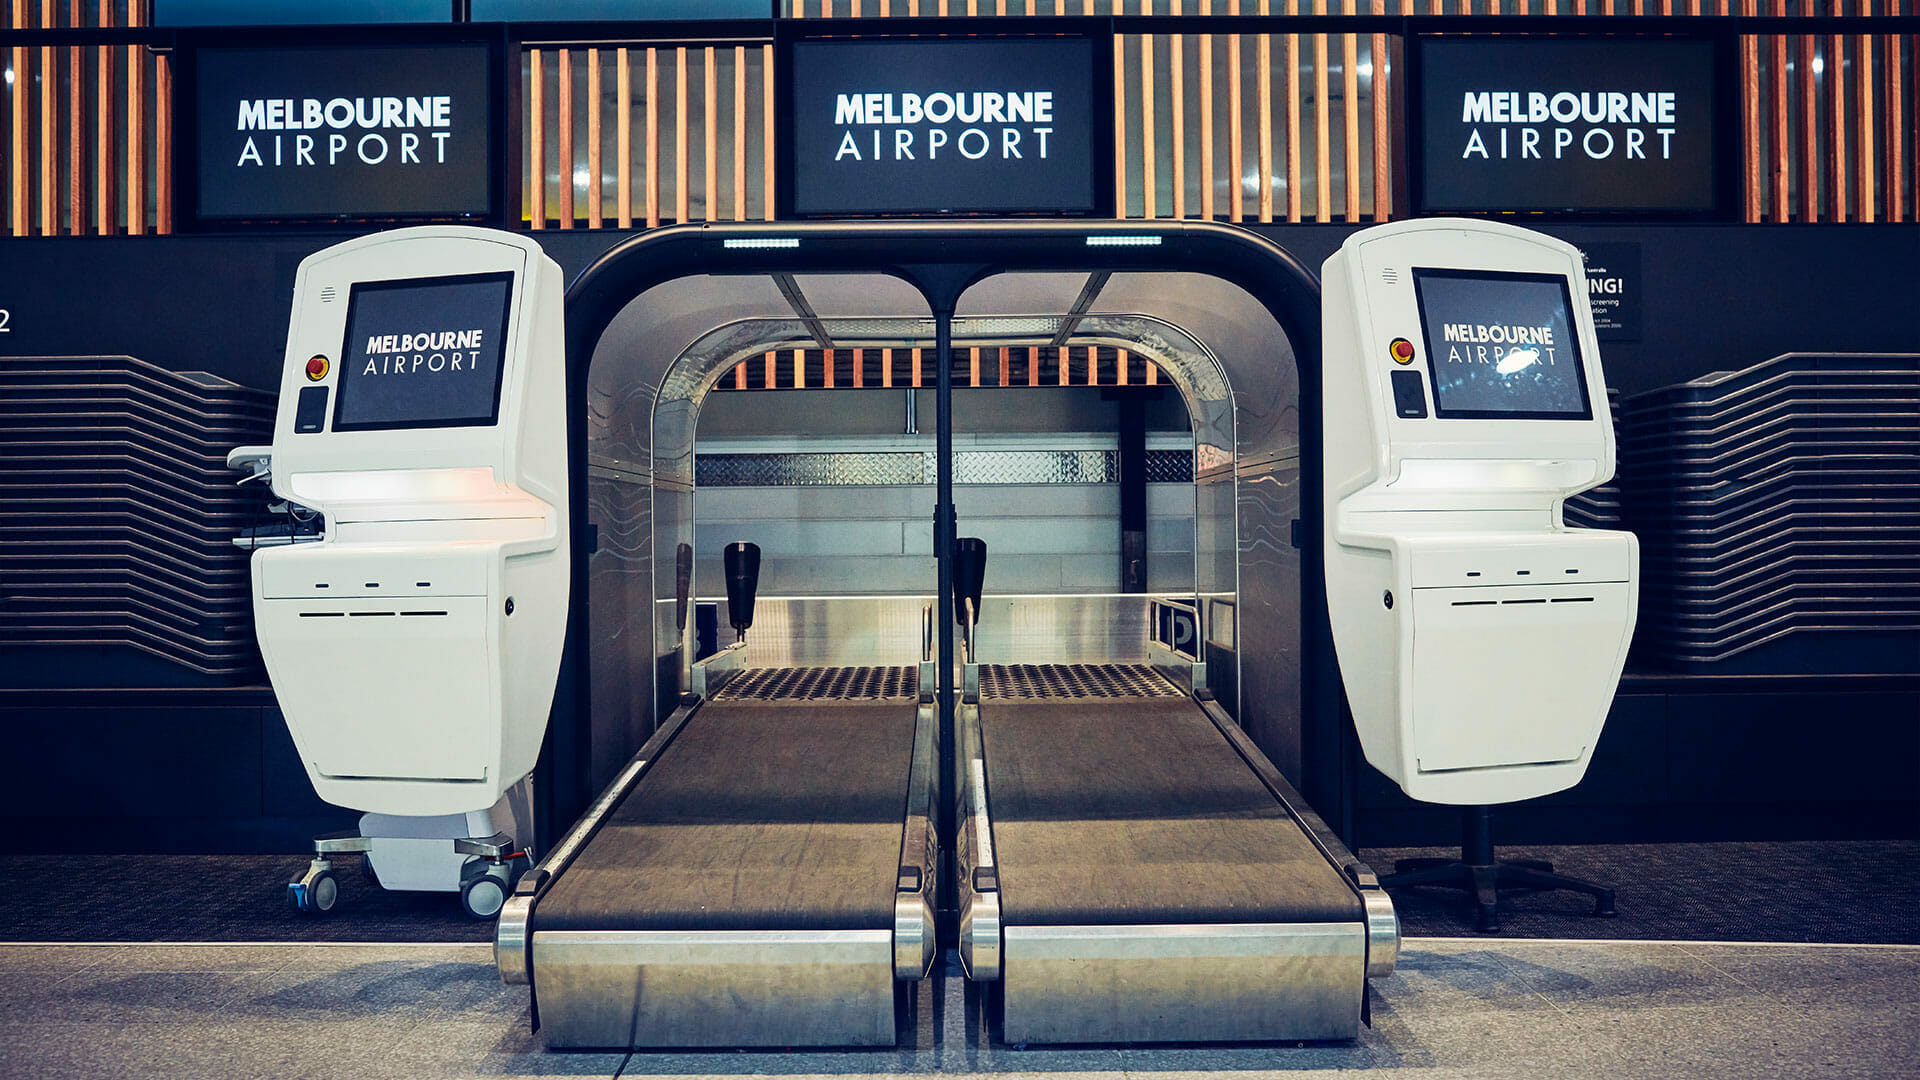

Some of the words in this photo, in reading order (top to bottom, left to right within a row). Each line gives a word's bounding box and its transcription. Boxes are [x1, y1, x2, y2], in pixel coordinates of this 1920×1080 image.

[237, 95, 451, 130] MELBOURNE
[834, 91, 1053, 124] MELBOURNE
[1462, 91, 1676, 124] MELBOURNE
[237, 132, 451, 167] AIRPORT
[834, 127, 1054, 161] AIRPORT
[1462, 127, 1677, 160] AIRPORT
[366, 329, 483, 354] MELBOURNE
[1443, 323, 1554, 345] MELBOURNE
[362, 351, 481, 376] AIRPORT
